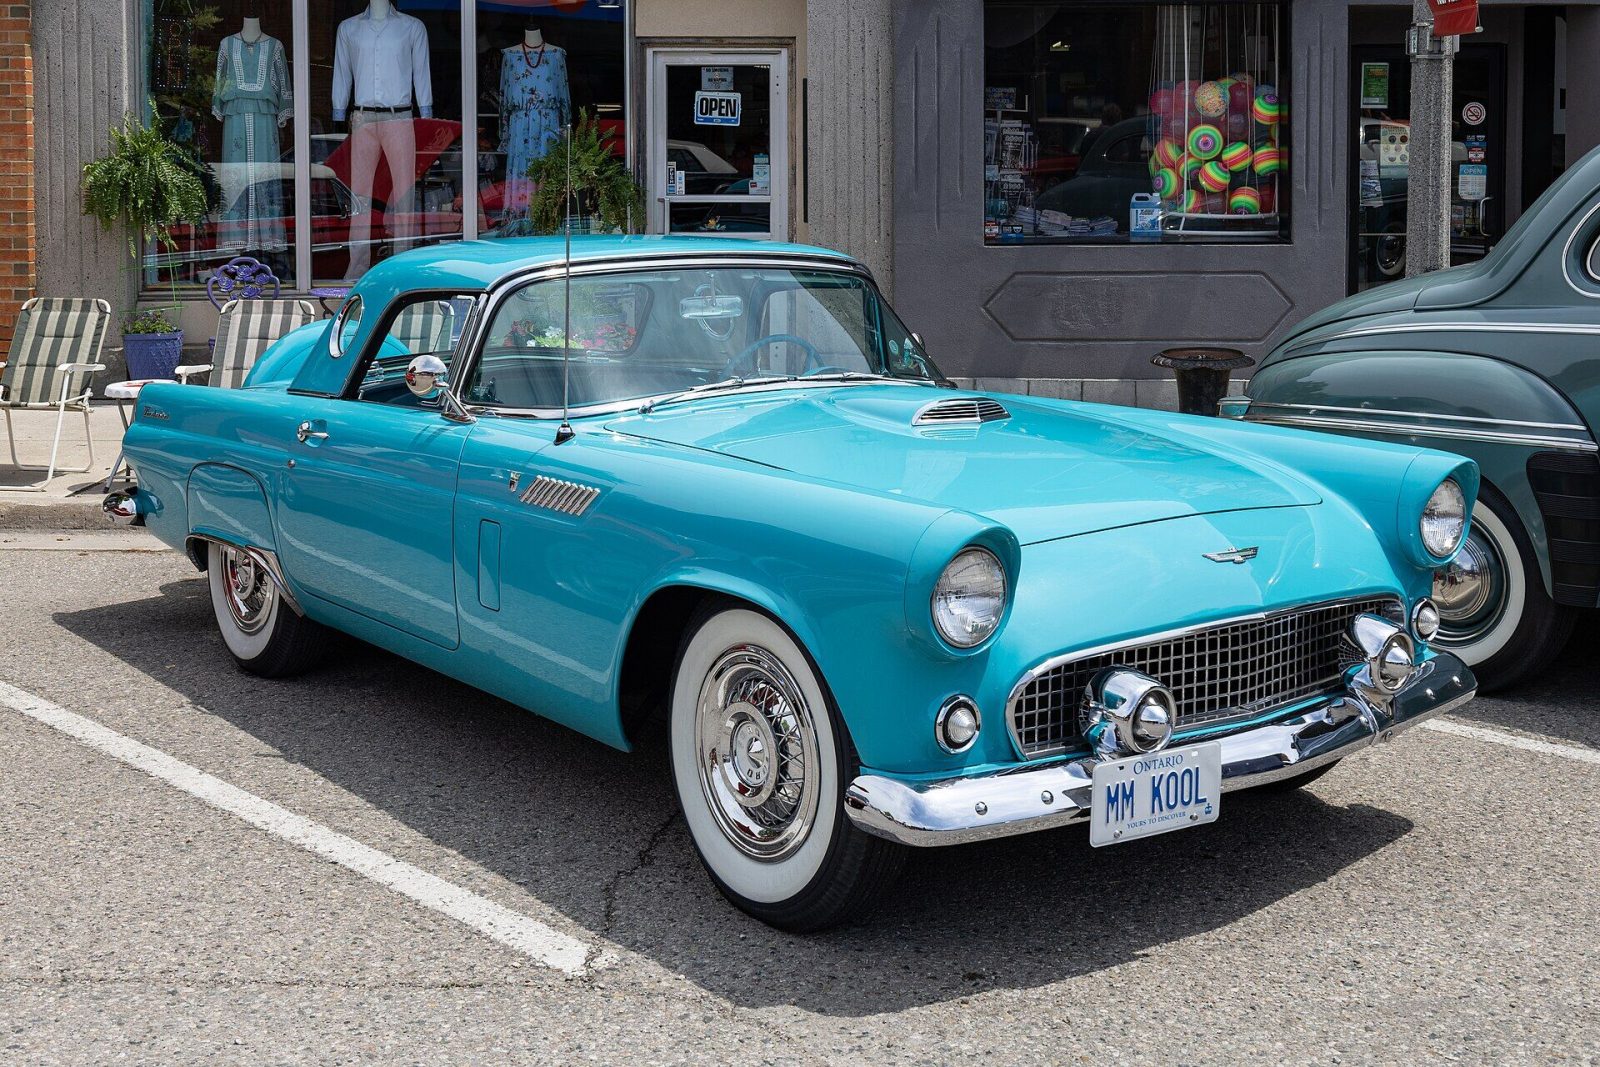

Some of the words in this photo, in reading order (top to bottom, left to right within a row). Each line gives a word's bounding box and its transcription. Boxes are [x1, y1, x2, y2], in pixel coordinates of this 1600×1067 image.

[699, 97, 737, 118] OPEN
[1133, 754, 1184, 775] ONTARIO
[1106, 779, 1135, 824] MM
[1151, 766, 1208, 814] KOOL
[1127, 820, 1146, 829] YOURS
[1158, 811, 1186, 822] DISCOVER
